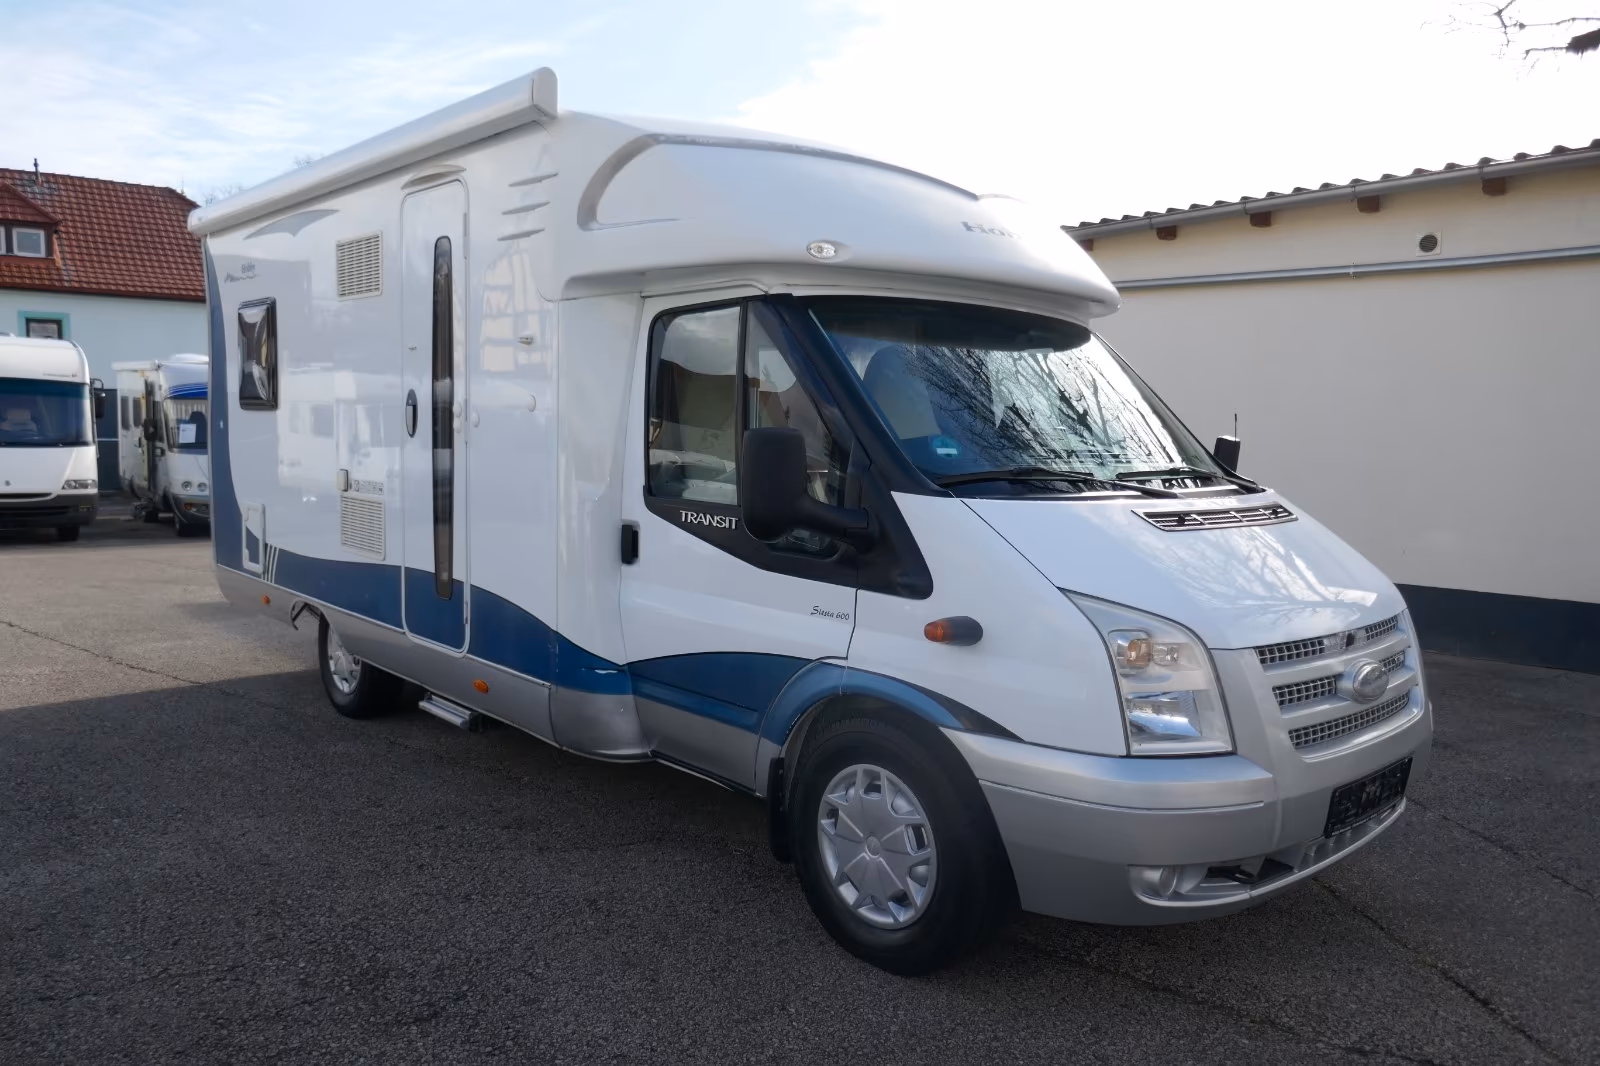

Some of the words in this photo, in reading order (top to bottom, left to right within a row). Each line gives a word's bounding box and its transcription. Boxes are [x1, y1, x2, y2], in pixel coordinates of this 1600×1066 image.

[680, 510, 738, 530] TRANSIT
[810, 605, 835, 618] Siesta
[835, 612, 850, 620] 600
